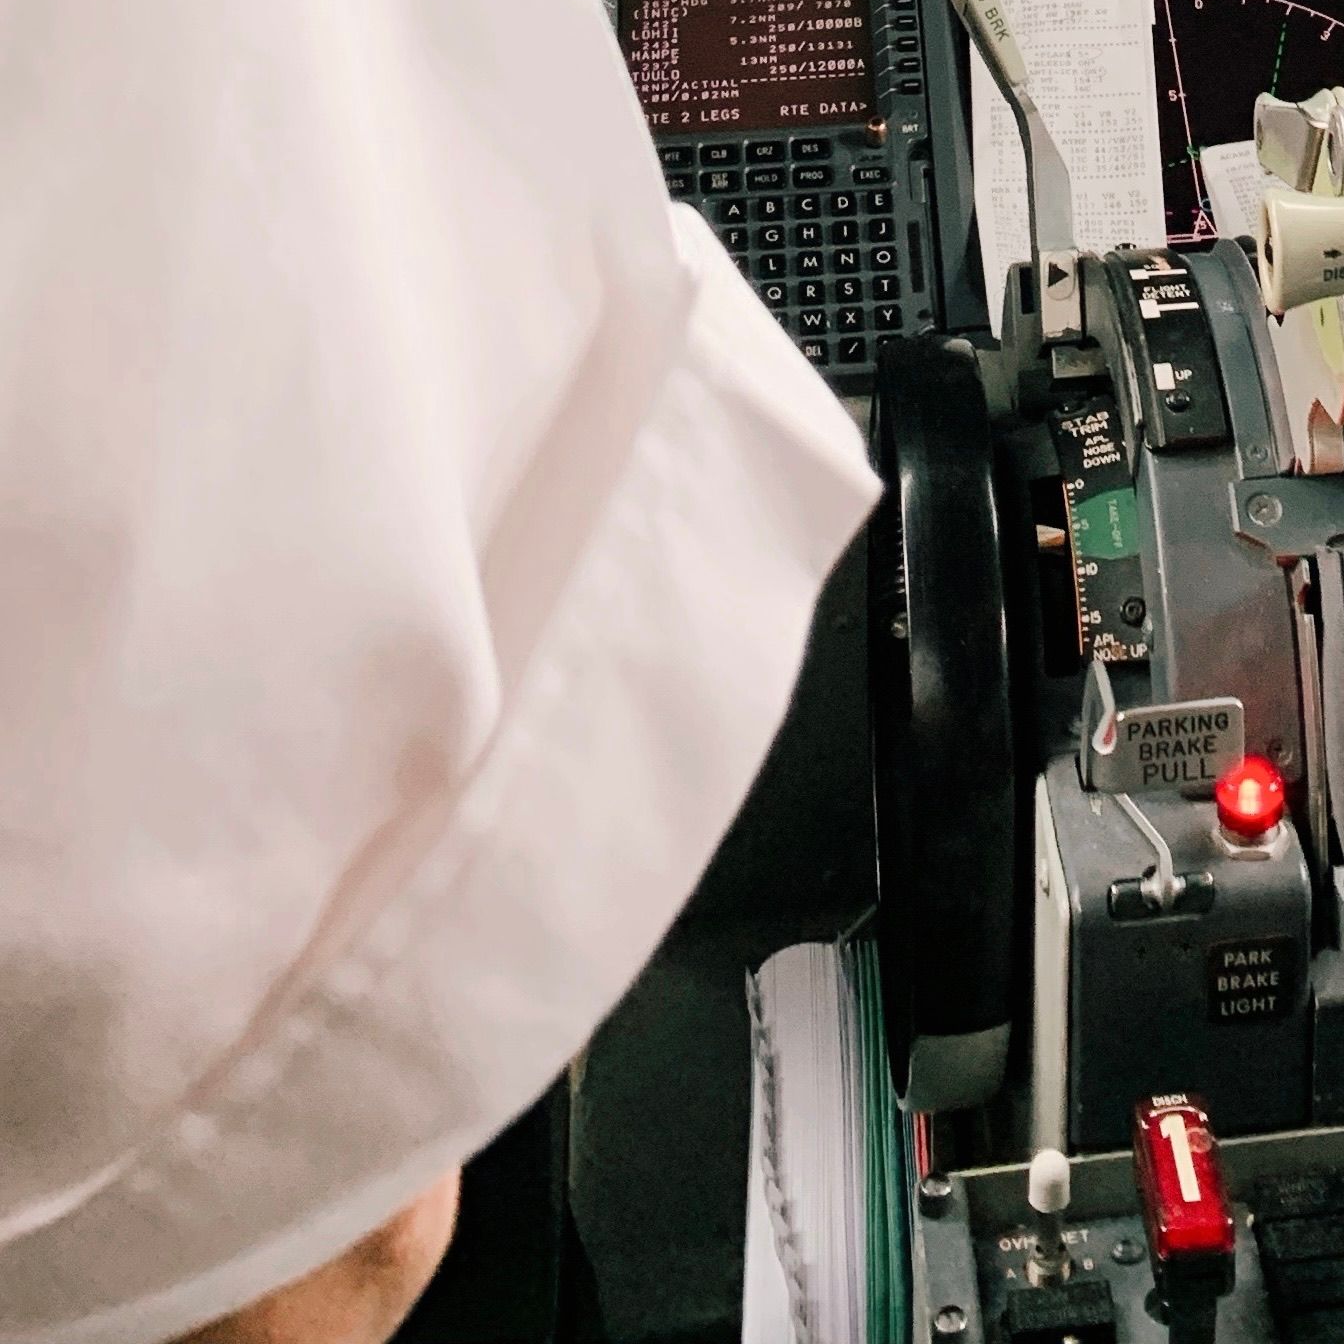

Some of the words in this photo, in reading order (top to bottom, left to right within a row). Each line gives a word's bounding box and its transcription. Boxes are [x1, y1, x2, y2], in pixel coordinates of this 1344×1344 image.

[982, 7, 1011, 42] BRK
[631, 49, 679, 61] HAWPE
[1174, 369, 1192, 381] UP
[1127, 713, 1229, 741] PARKING
[1139, 735, 1218, 761] BRAKE
[1142, 759, 1216, 785] PULL
[1224, 948, 1272, 967] PARK
[1217, 971, 1280, 992] BRAKE
[1220, 996, 1278, 1016] LIGHT
[1152, 1094, 1187, 1107] DISCH
[1159, 1114, 1201, 1202] 1
